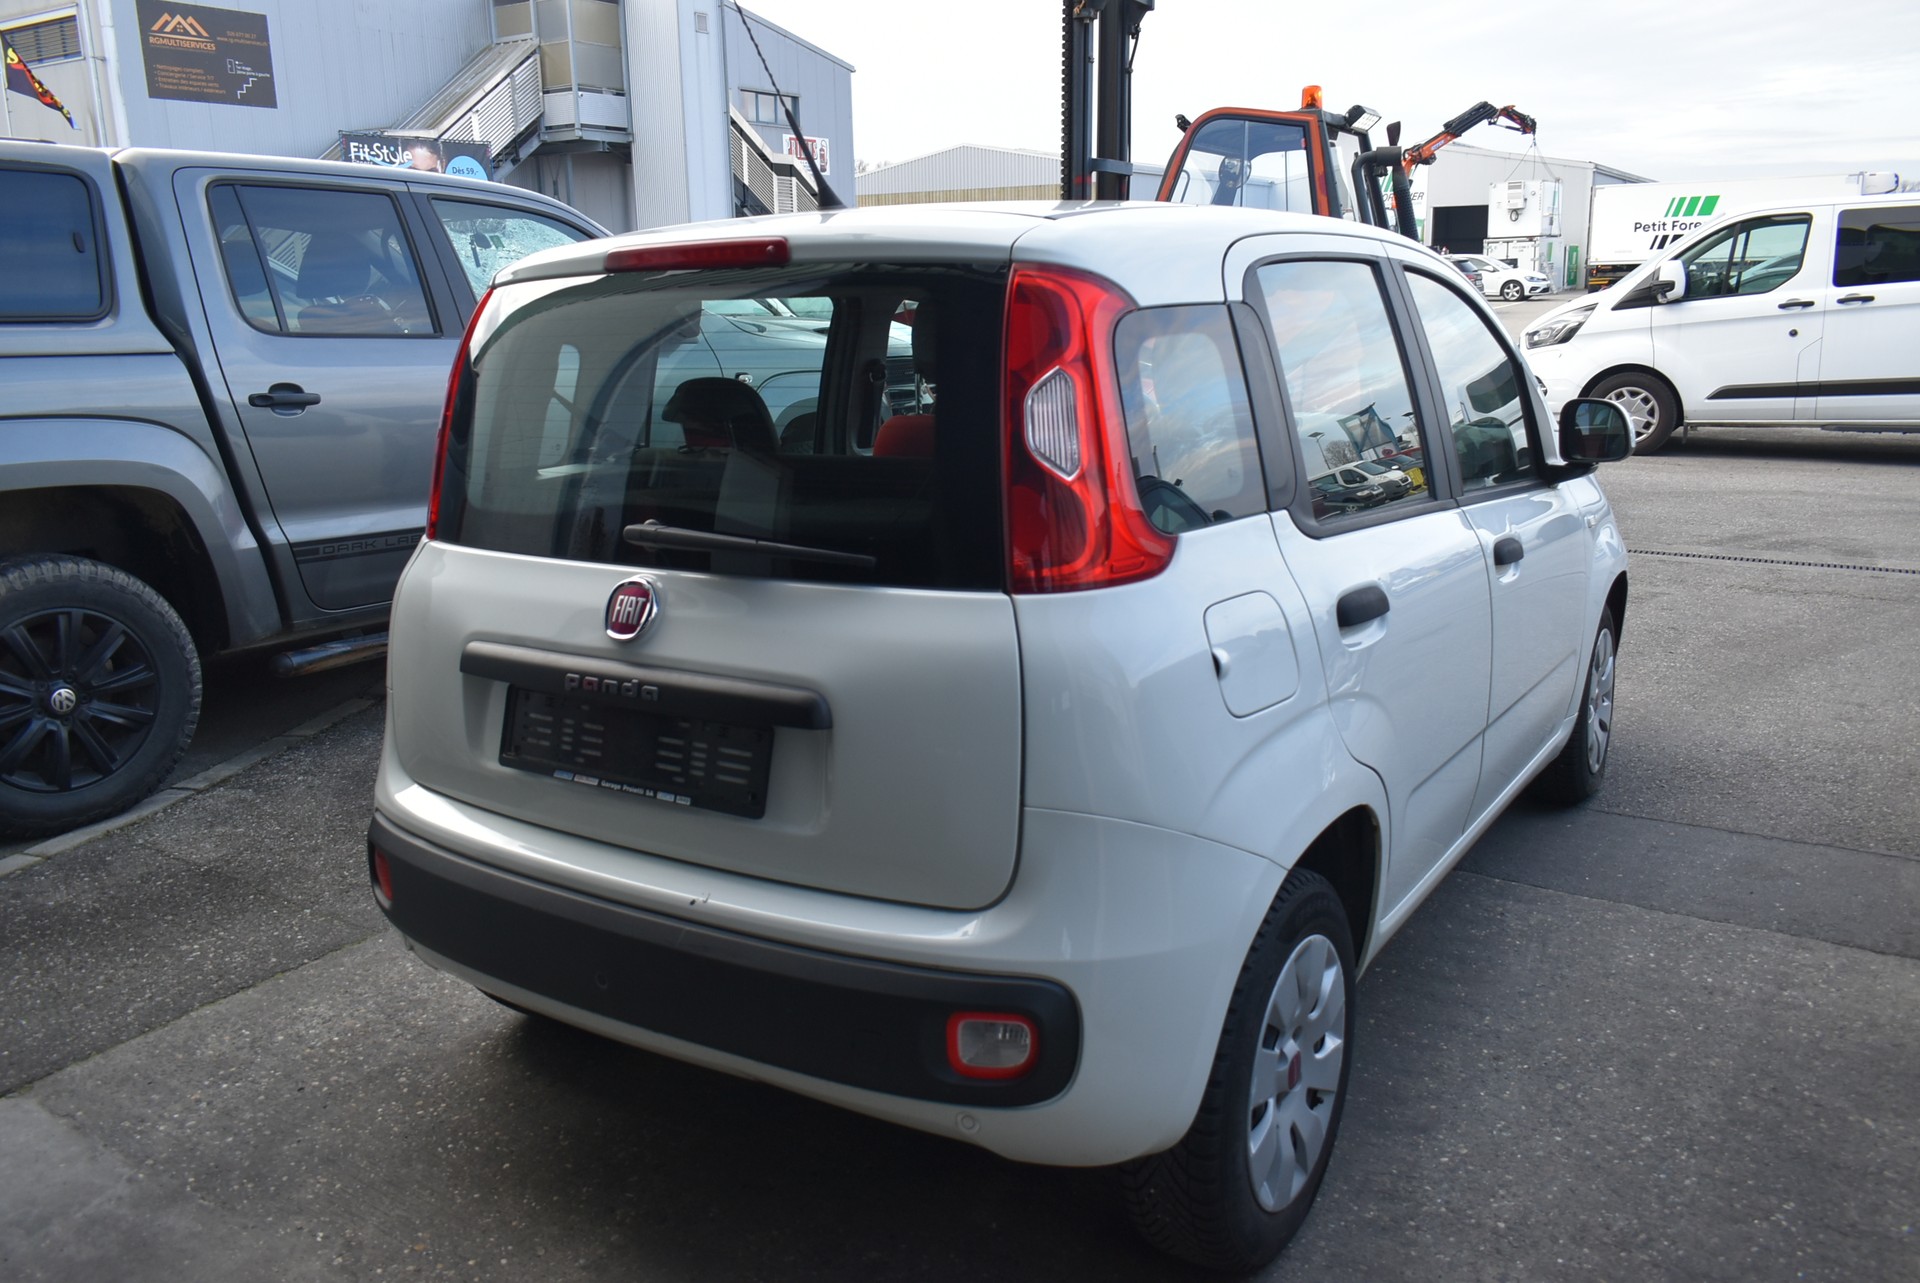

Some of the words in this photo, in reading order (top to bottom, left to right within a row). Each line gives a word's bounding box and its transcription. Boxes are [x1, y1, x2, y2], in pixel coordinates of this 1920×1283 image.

[349, 141, 413, 167] Fit-Style
[1634, 220, 1667, 232] Petit
[322, 541, 376, 555] DARK
[611, 594, 647, 626] FIAT
[565, 672, 659, 701] panda
